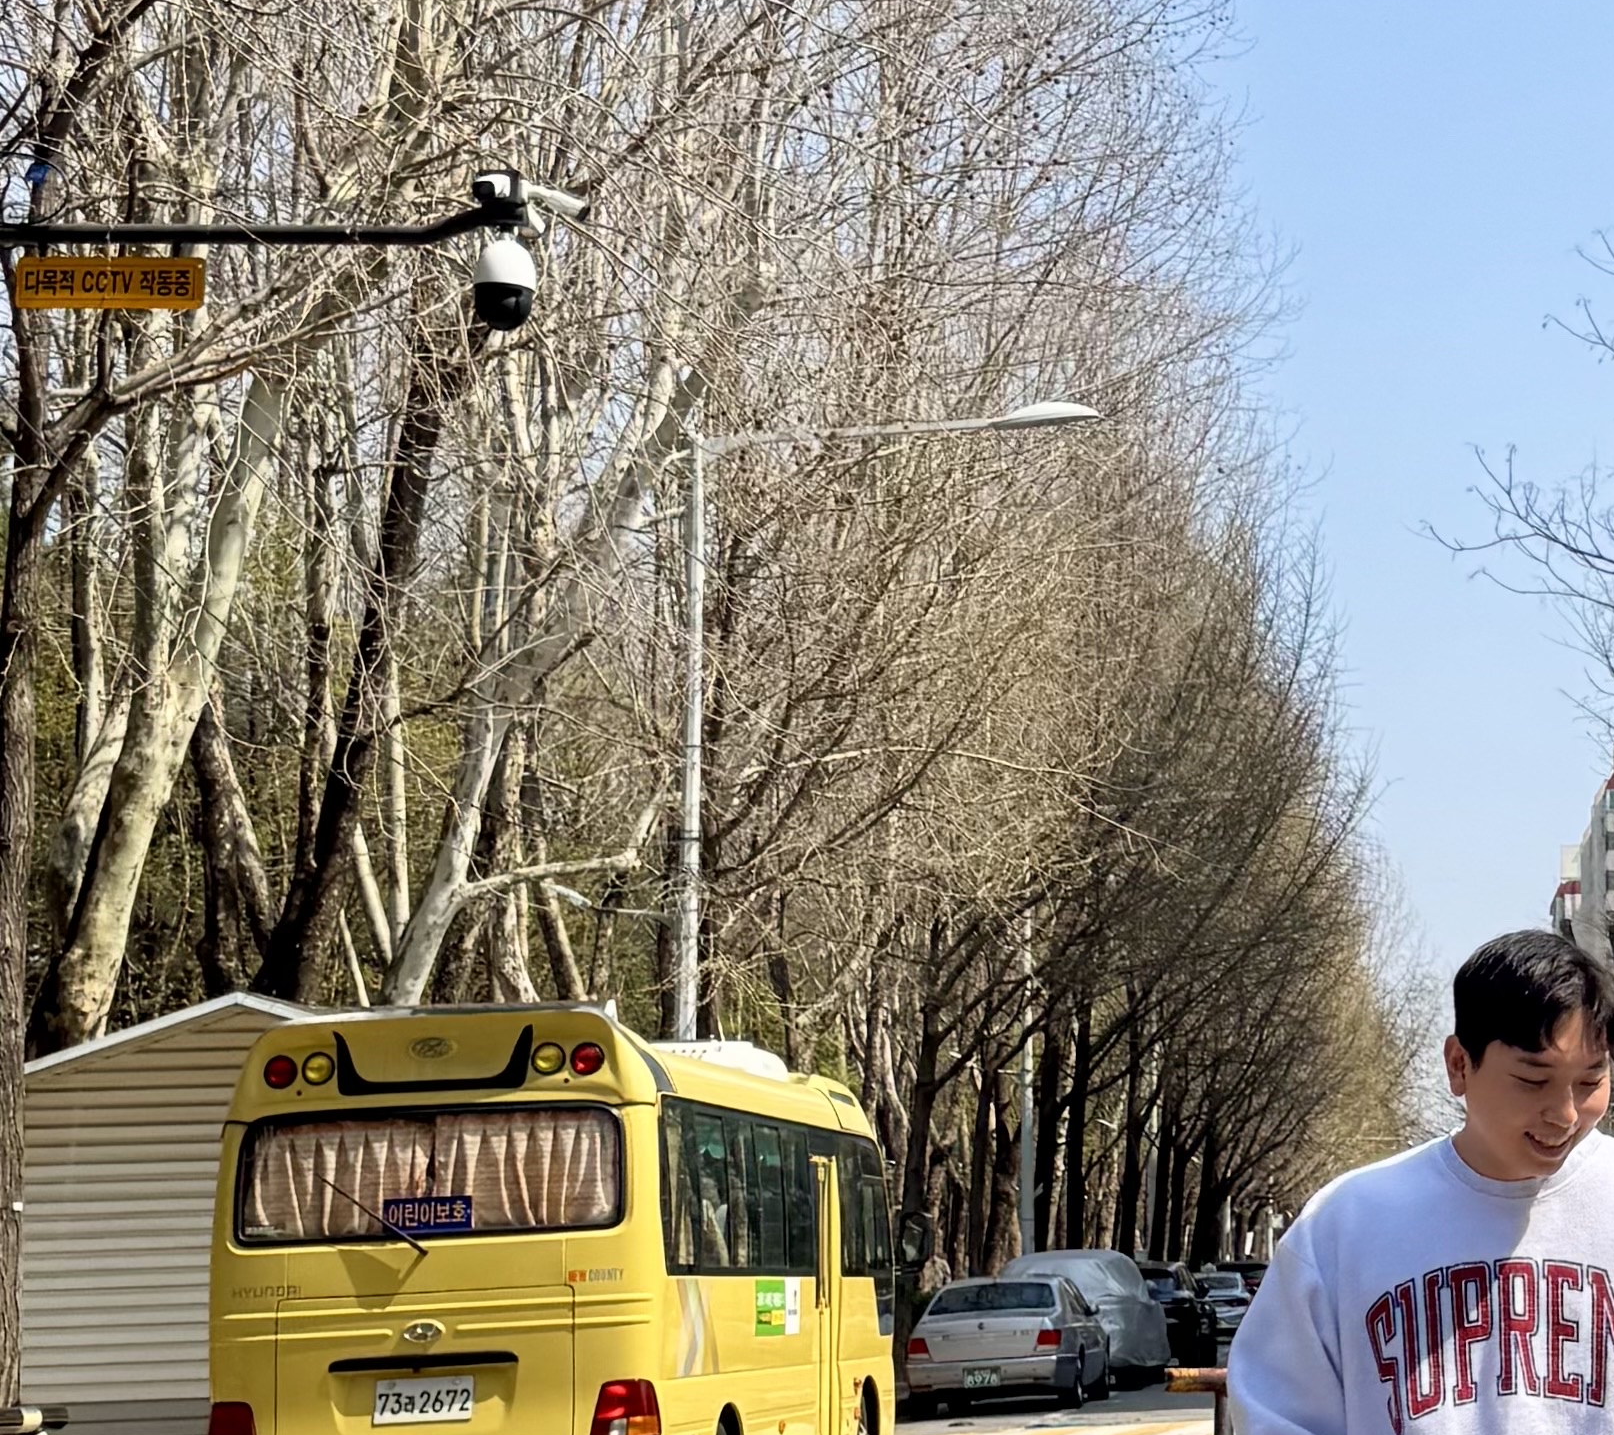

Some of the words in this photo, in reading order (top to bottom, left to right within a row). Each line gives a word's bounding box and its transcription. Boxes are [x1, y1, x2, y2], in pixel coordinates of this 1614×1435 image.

[25, 269, 75, 296] 다목적
[81, 270, 133, 294] CCTV
[140, 269, 191, 296] 작동중
[388, 1200, 467, 1227] 어린이보호
[232, 1286, 302, 1298] HYUNDAI
